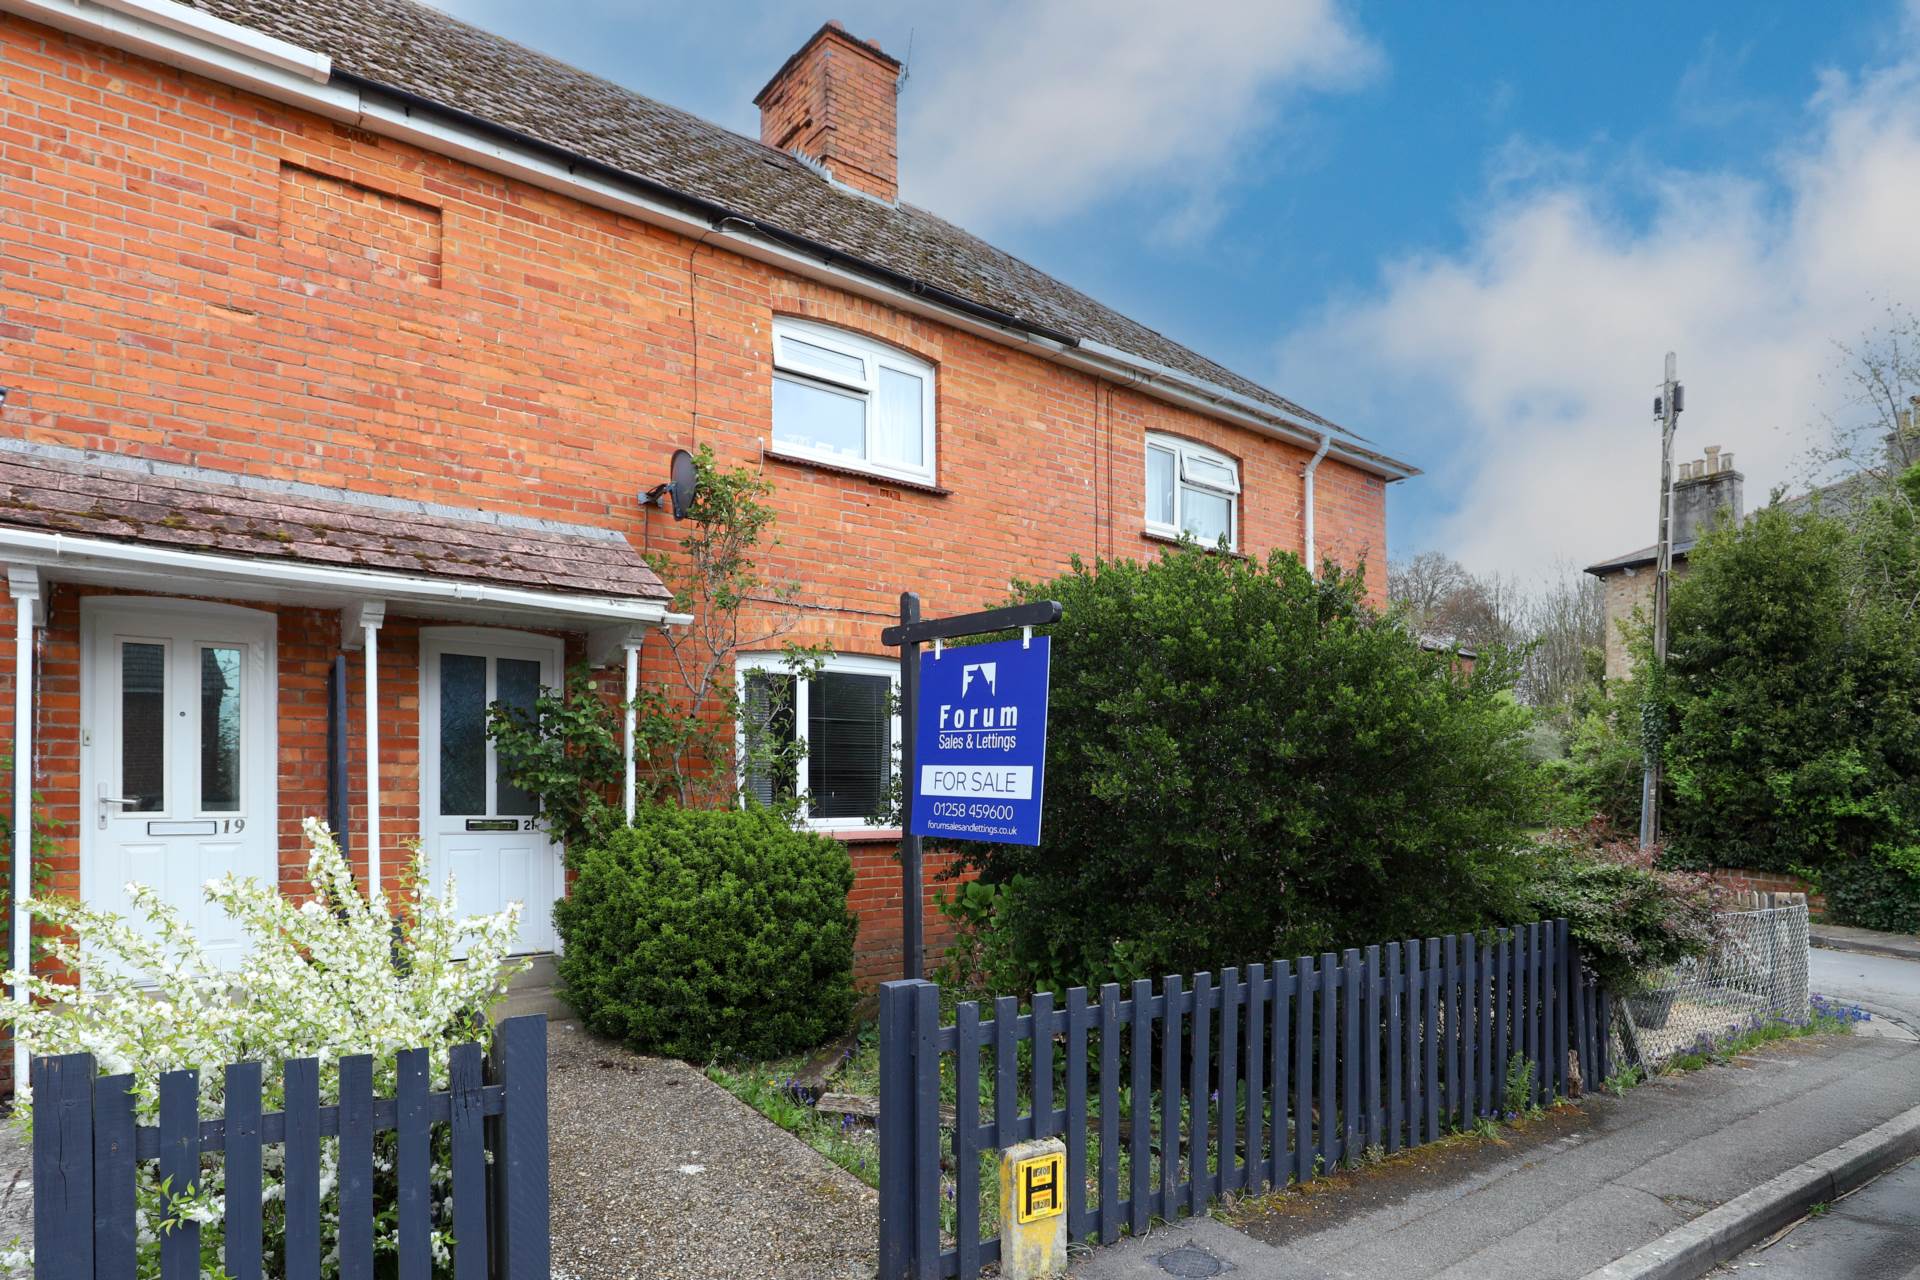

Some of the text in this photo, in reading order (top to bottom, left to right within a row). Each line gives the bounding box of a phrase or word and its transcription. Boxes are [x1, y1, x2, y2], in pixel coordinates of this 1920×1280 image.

[940, 704, 1018, 729] Forum
[939, 732, 1017, 752] Sales & Lettings
[934, 771, 1017, 793] FOR SALE
[933, 801, 1014, 820] 01258 459600
[223, 818, 245, 834] 19
[927, 819, 1018, 836] forumsalesandlettings.co.uk
[1025, 1160, 1057, 1216] H
